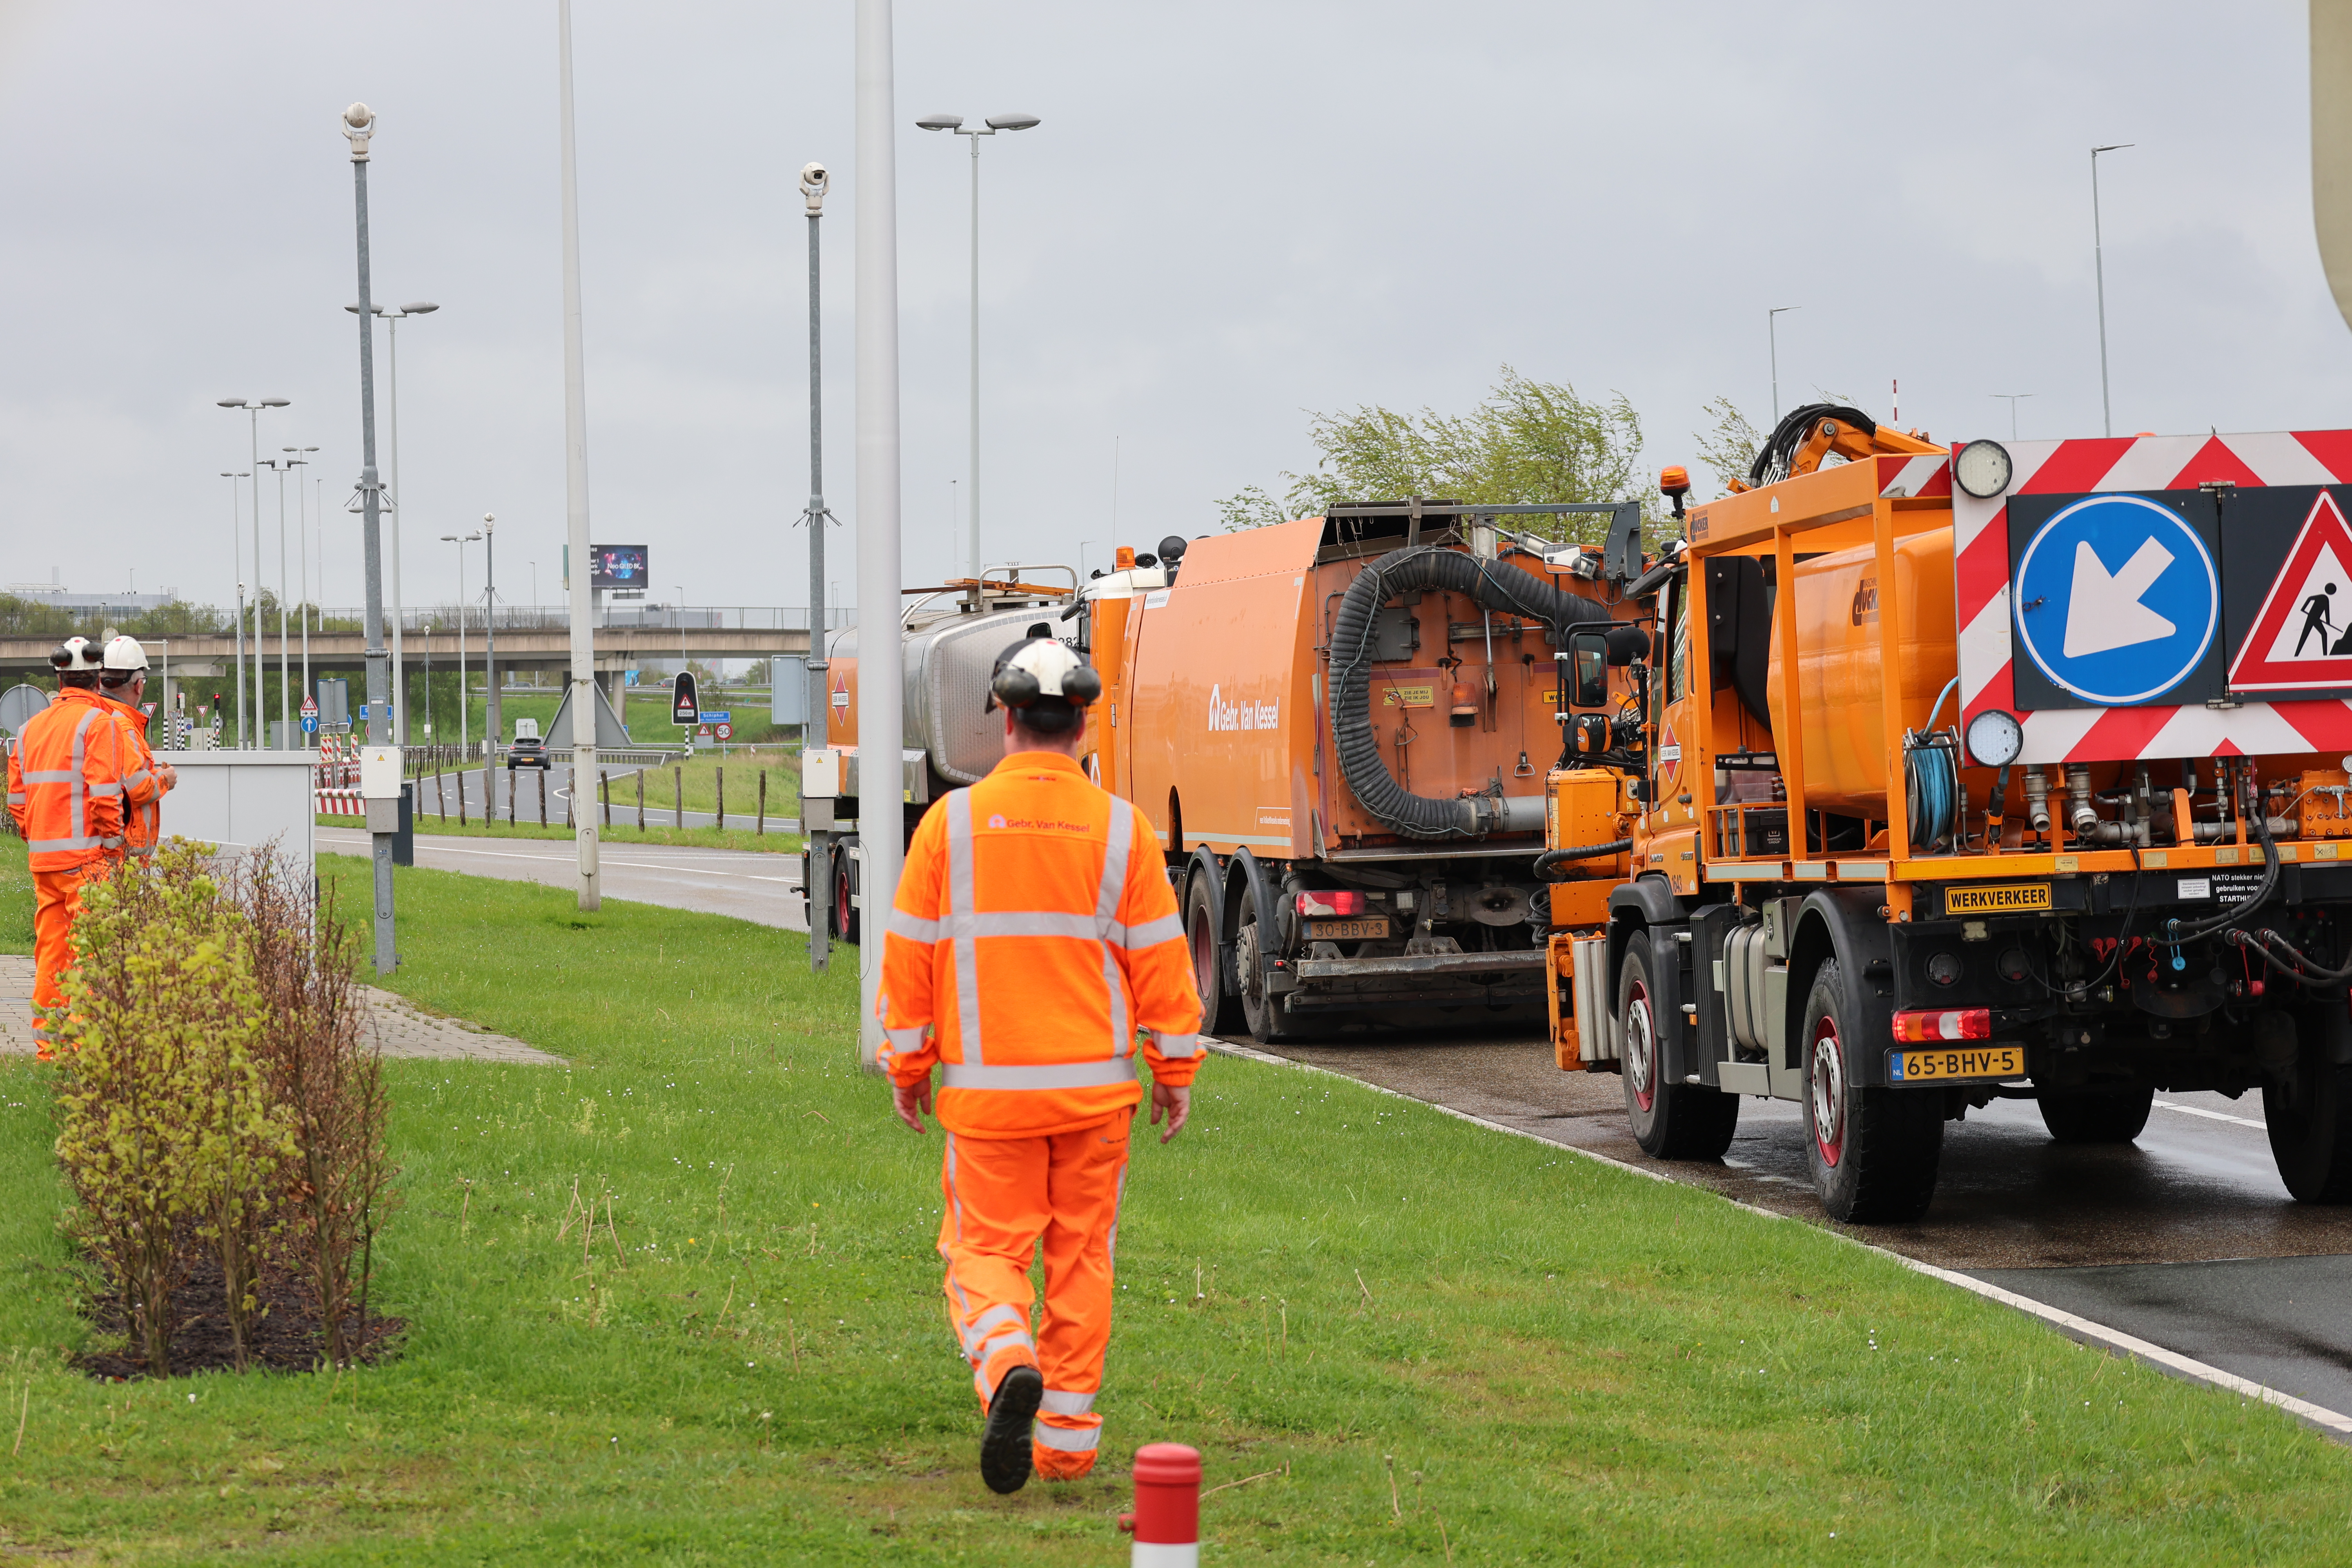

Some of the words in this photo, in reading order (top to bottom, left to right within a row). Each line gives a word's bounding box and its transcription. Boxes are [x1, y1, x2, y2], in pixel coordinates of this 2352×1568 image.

[1221, 700, 1238, 731] Gebr.
[1241, 701, 1253, 730] Van
[1254, 697, 1279, 730] Kessel
[1007, 818, 1034, 828] Gebr.
[1036, 820, 1055, 829] Van
[1058, 820, 1090, 832] Kessel
[1671, 874, 1682, 893] 1643
[2216, 885, 2245, 893] gebruiken
[1951, 889, 2046, 908] WERKVERKEER
[1316, 922, 1383, 936] 30-BBV-3
[1907, 1051, 2014, 1075] 65-BHV-5
